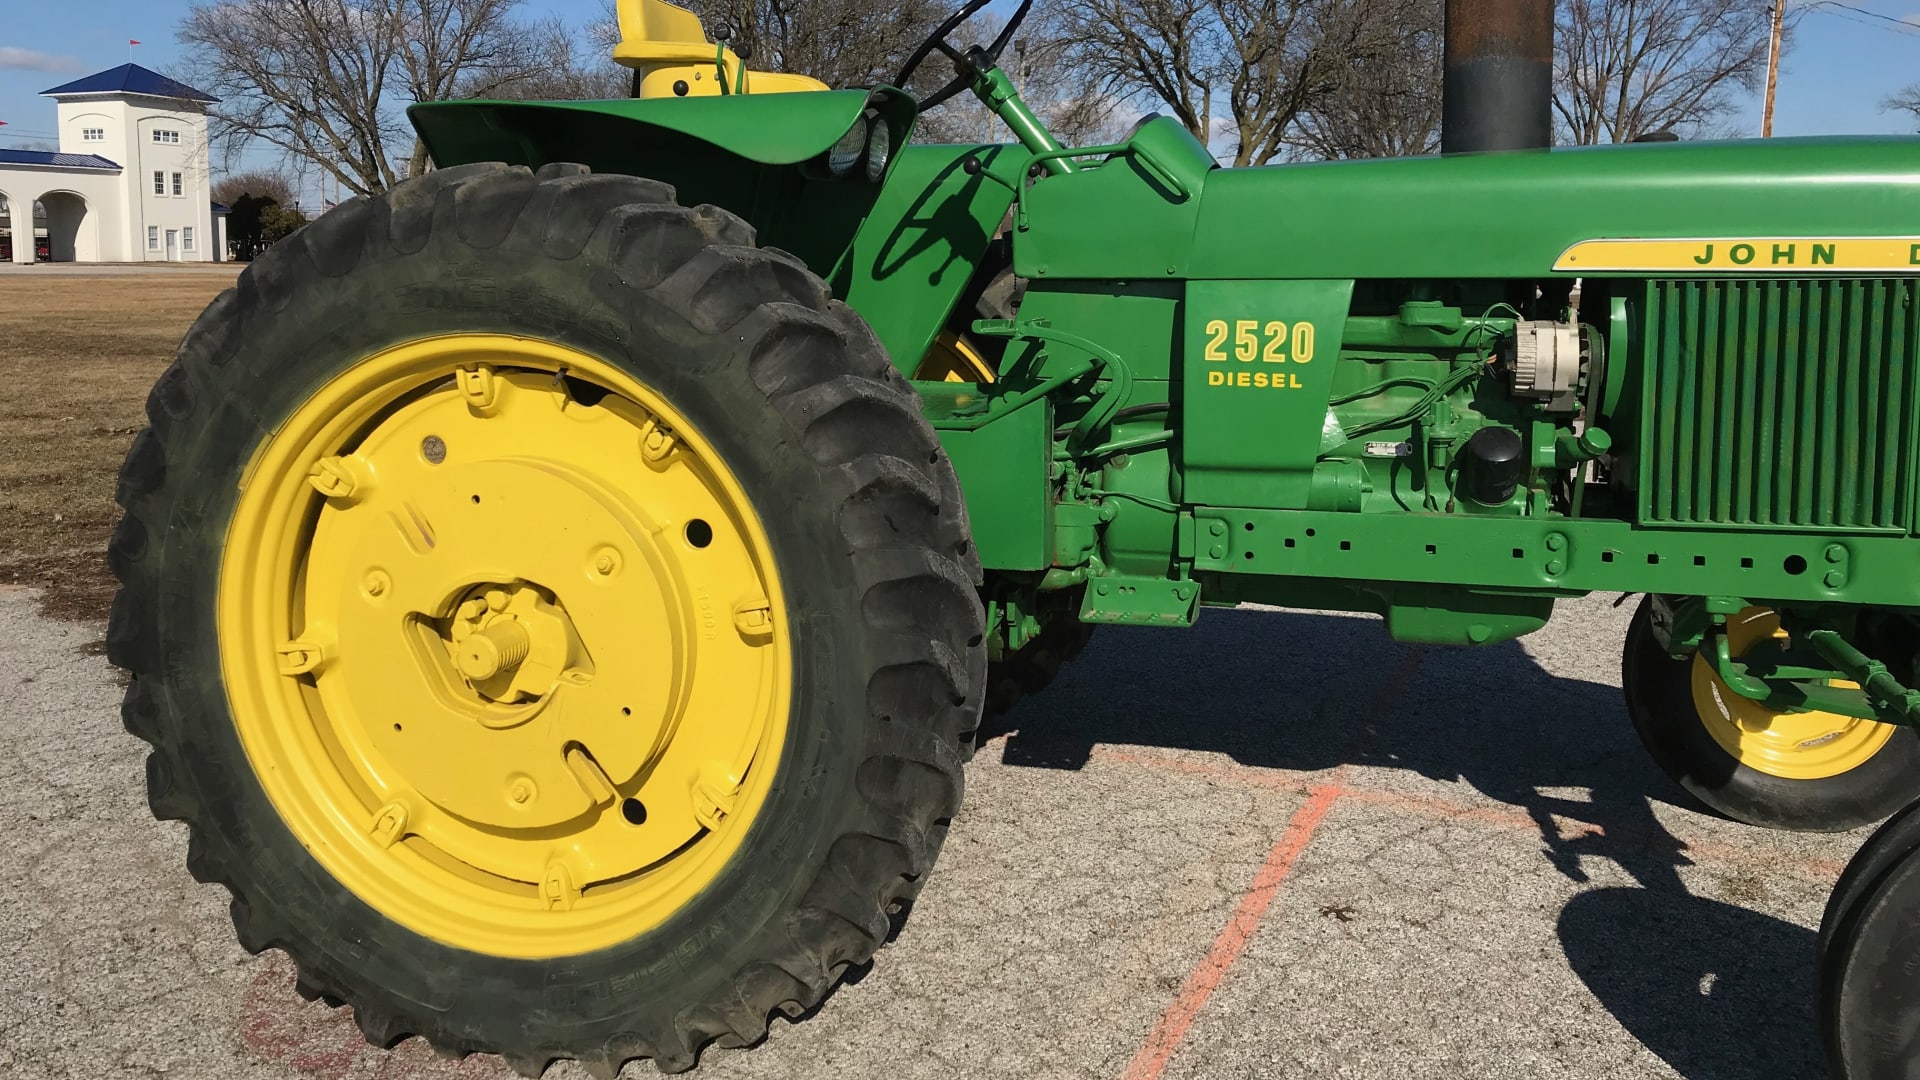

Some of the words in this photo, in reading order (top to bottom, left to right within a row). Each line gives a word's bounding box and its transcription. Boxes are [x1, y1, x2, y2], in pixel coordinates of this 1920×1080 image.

[1693, 243, 1836, 265] JOHN
[1204, 319, 1315, 364] 2520
[1208, 371, 1303, 388] DIESEL
